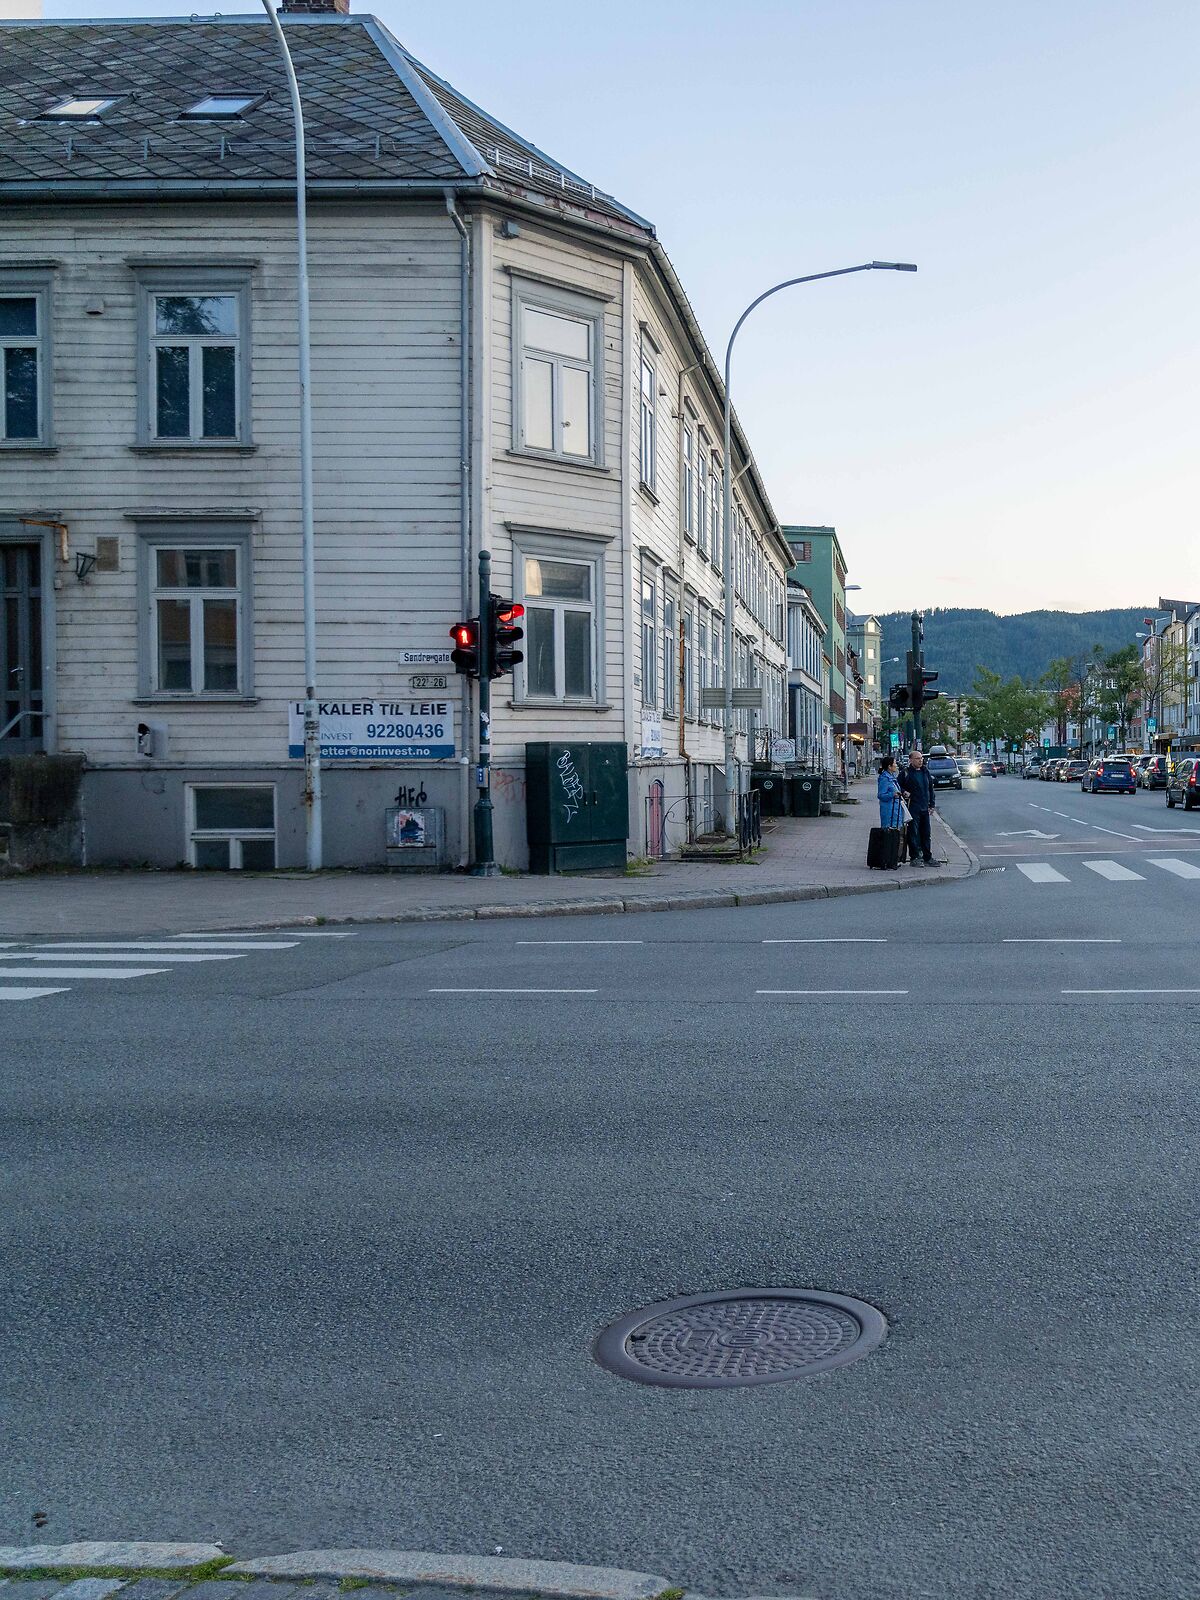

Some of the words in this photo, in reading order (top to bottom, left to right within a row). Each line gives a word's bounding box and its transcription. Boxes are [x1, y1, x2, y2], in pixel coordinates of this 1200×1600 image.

[433, 653, 450, 664] gate
[296, 703, 374, 716] LKALER
[379, 703, 404, 716] TIL
[410, 703, 448, 716] LEIE
[320, 732, 353, 741] INVEST
[367, 723, 444, 739] 92280436
[319, 746, 431, 756] etter@norinvest.no
